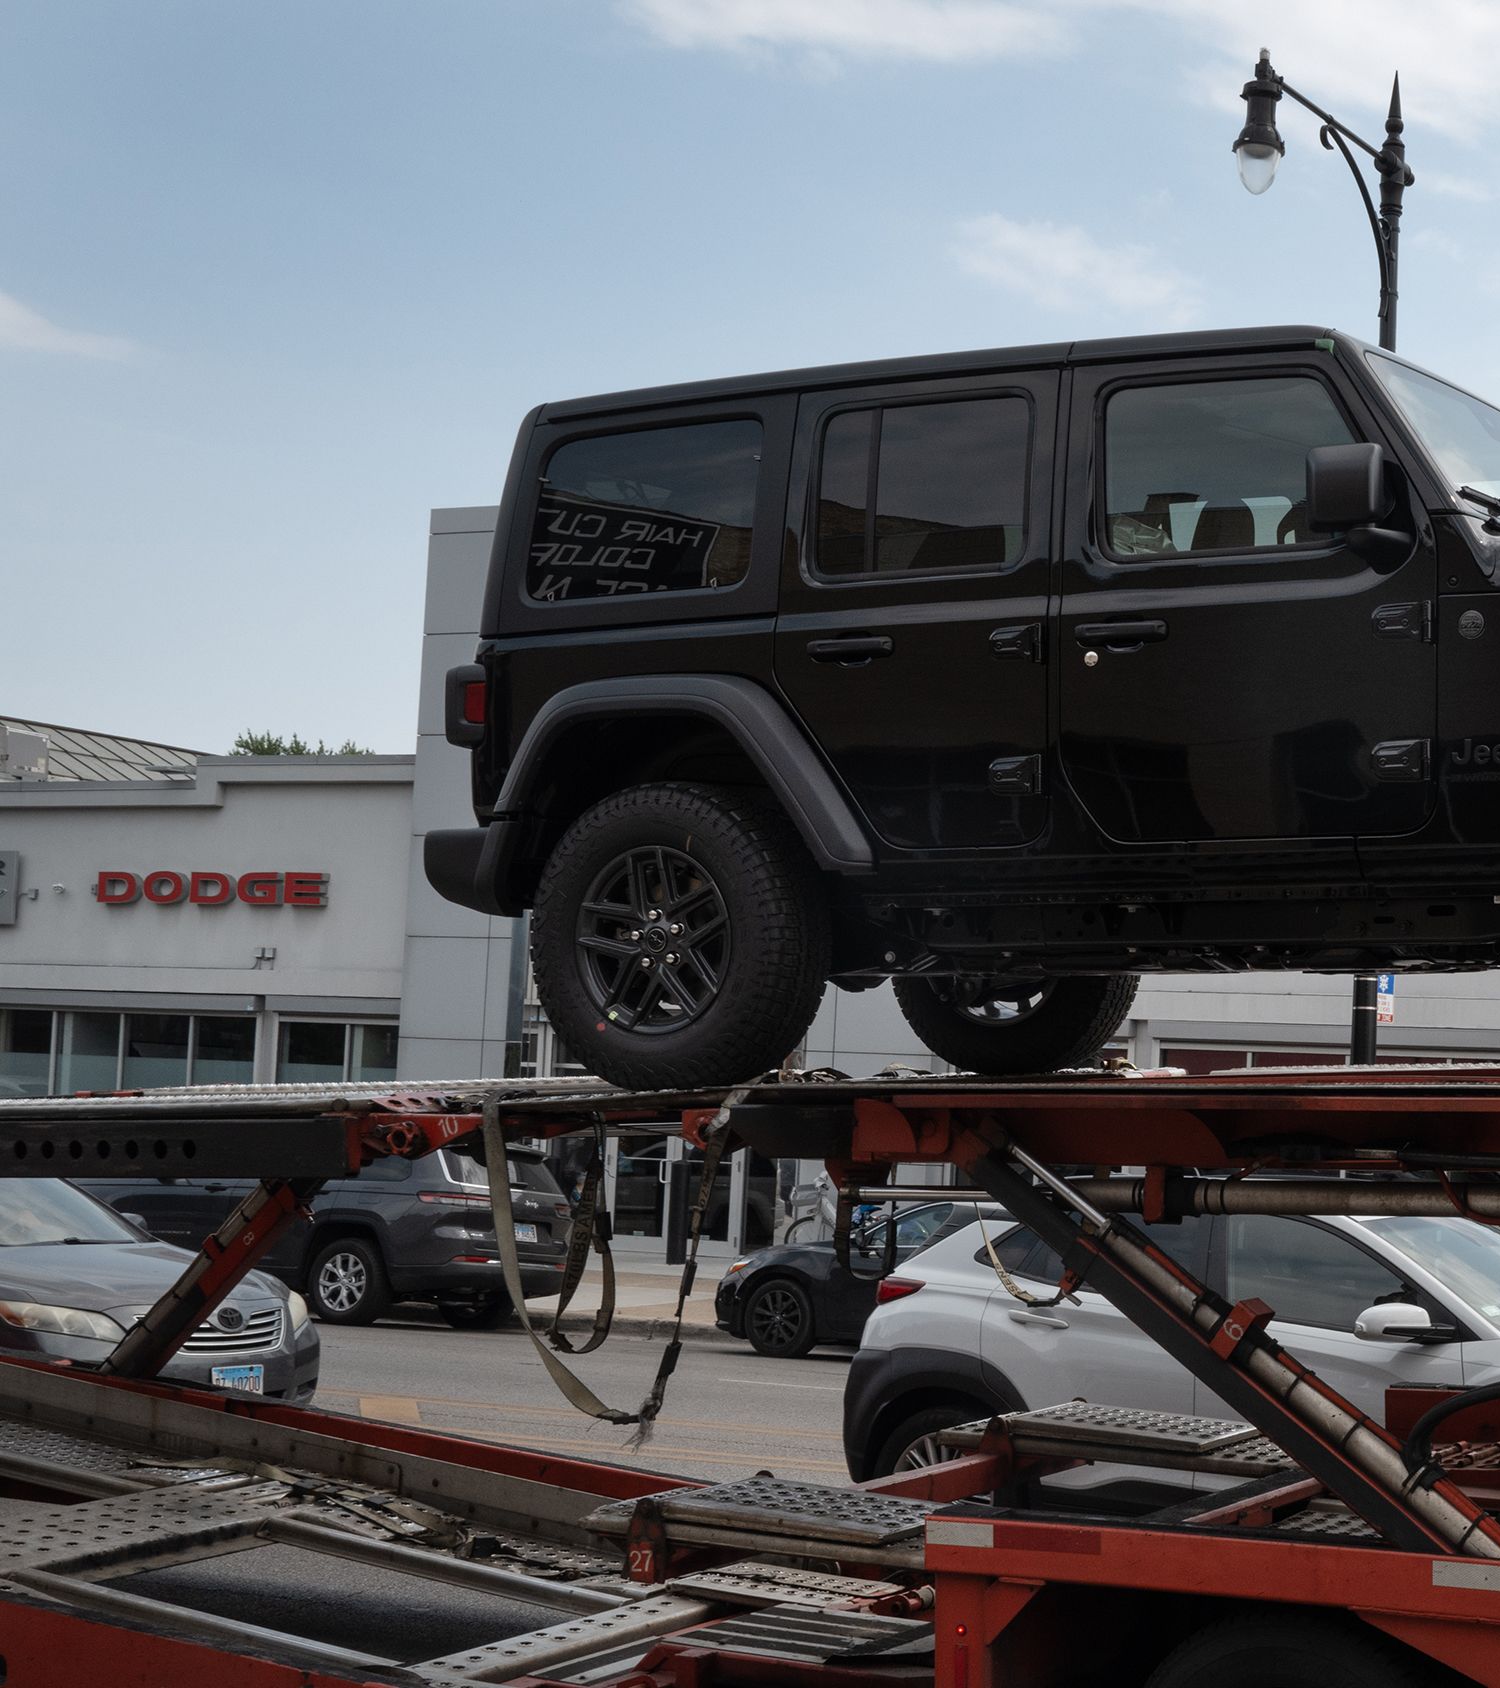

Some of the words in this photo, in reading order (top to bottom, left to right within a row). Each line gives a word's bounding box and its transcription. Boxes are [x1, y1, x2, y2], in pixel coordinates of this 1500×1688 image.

[96, 870, 328, 906] DODGE
[438, 1116, 458, 1138] 10
[242, 1231, 255, 1246] 8
[629, 1550, 653, 1572] 27
